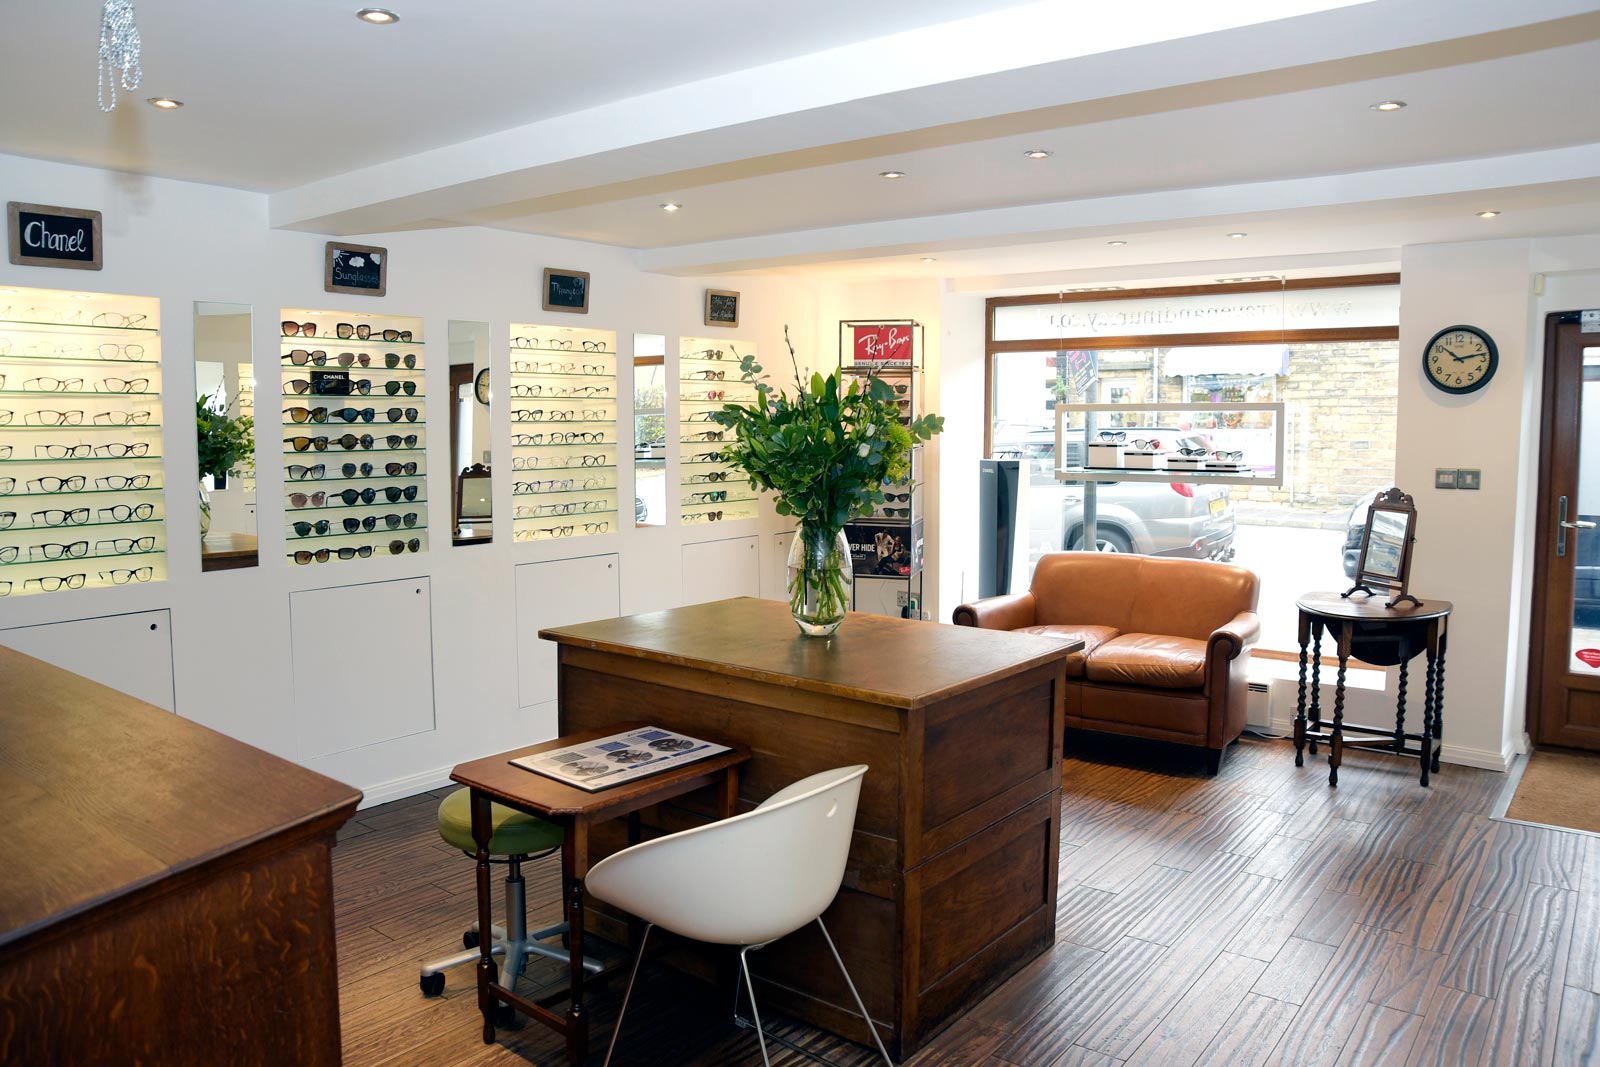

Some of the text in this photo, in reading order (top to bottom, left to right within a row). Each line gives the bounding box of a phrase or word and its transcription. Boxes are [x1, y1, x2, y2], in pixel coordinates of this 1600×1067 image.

[24, 220, 87, 253] Chanel
[1445, 337, 1452, 346] 11
[1455, 334, 1464, 343] 12
[1435, 345, 1444, 353] 10
[1475, 343, 1482, 351] 2
[1432, 356, 1438, 364] 9
[1436, 366, 1442, 374] 8
[1445, 374, 1451, 382] 7
[861, 543, 875, 552] HIDE
